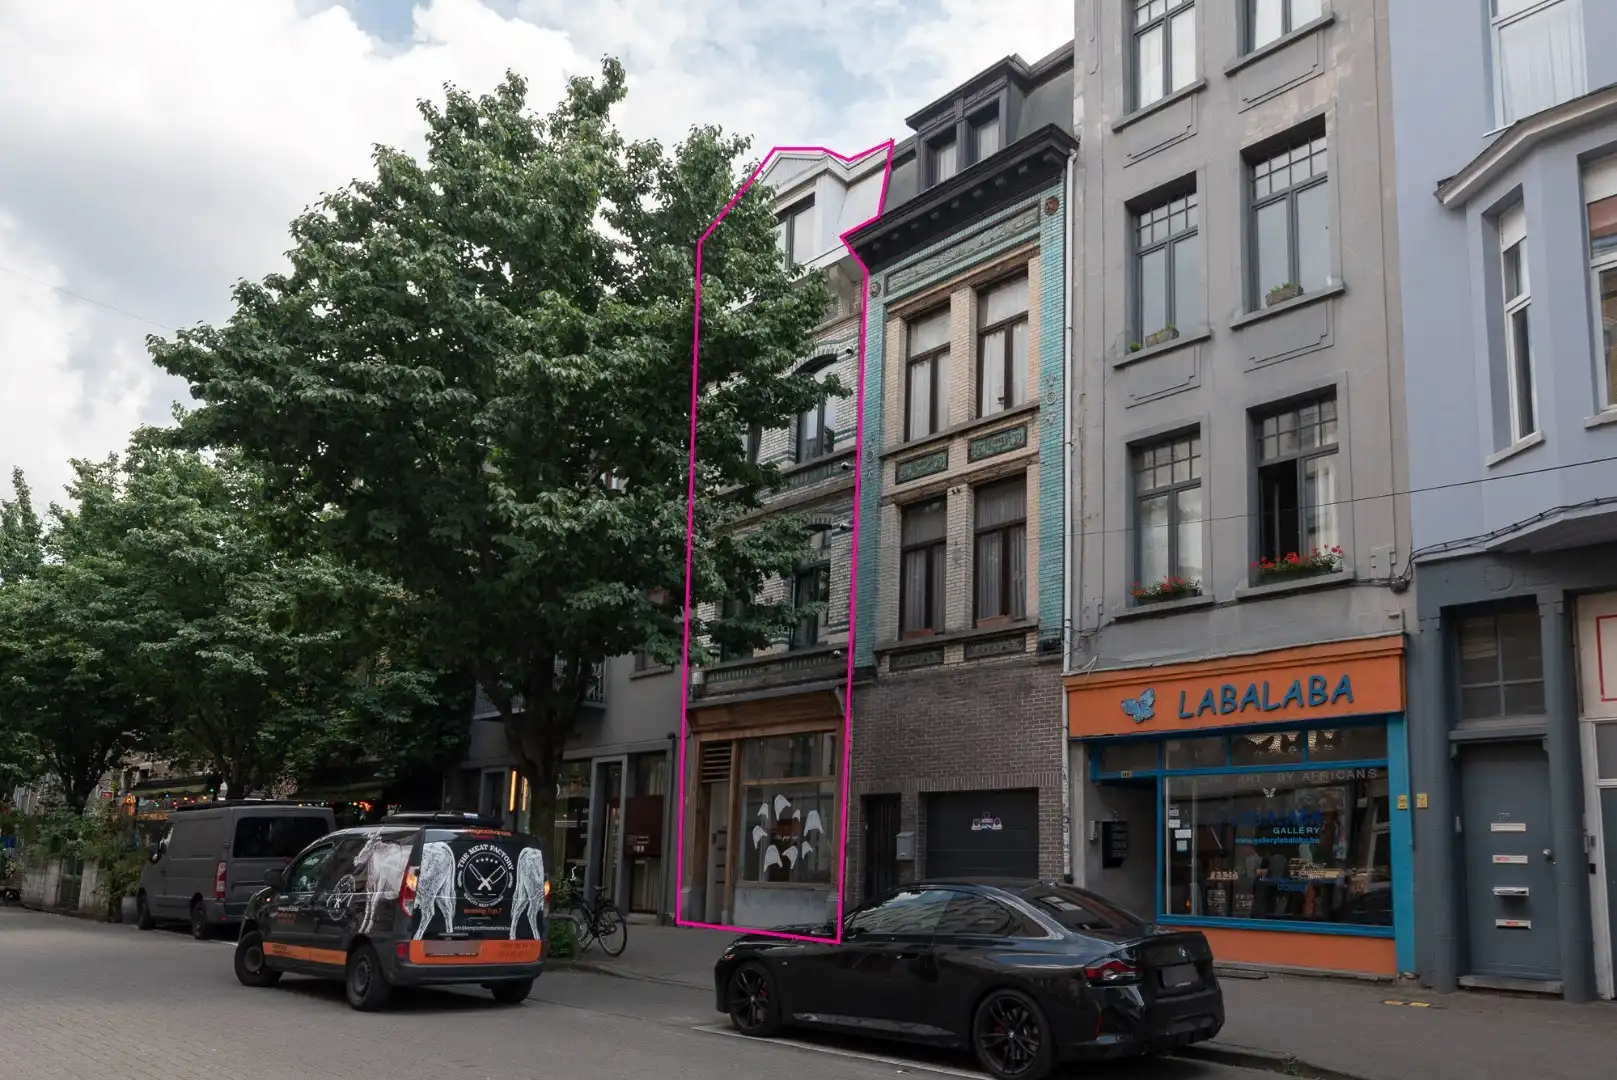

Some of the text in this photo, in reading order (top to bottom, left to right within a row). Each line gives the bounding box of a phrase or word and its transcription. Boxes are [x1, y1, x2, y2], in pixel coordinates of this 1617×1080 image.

[1177, 674, 1354, 719] LABALABA
[1277, 772, 1295, 782] BY
[1302, 768, 1378, 780] AFRICANS
[457, 843, 514, 870] THE MEAT FACTORY
